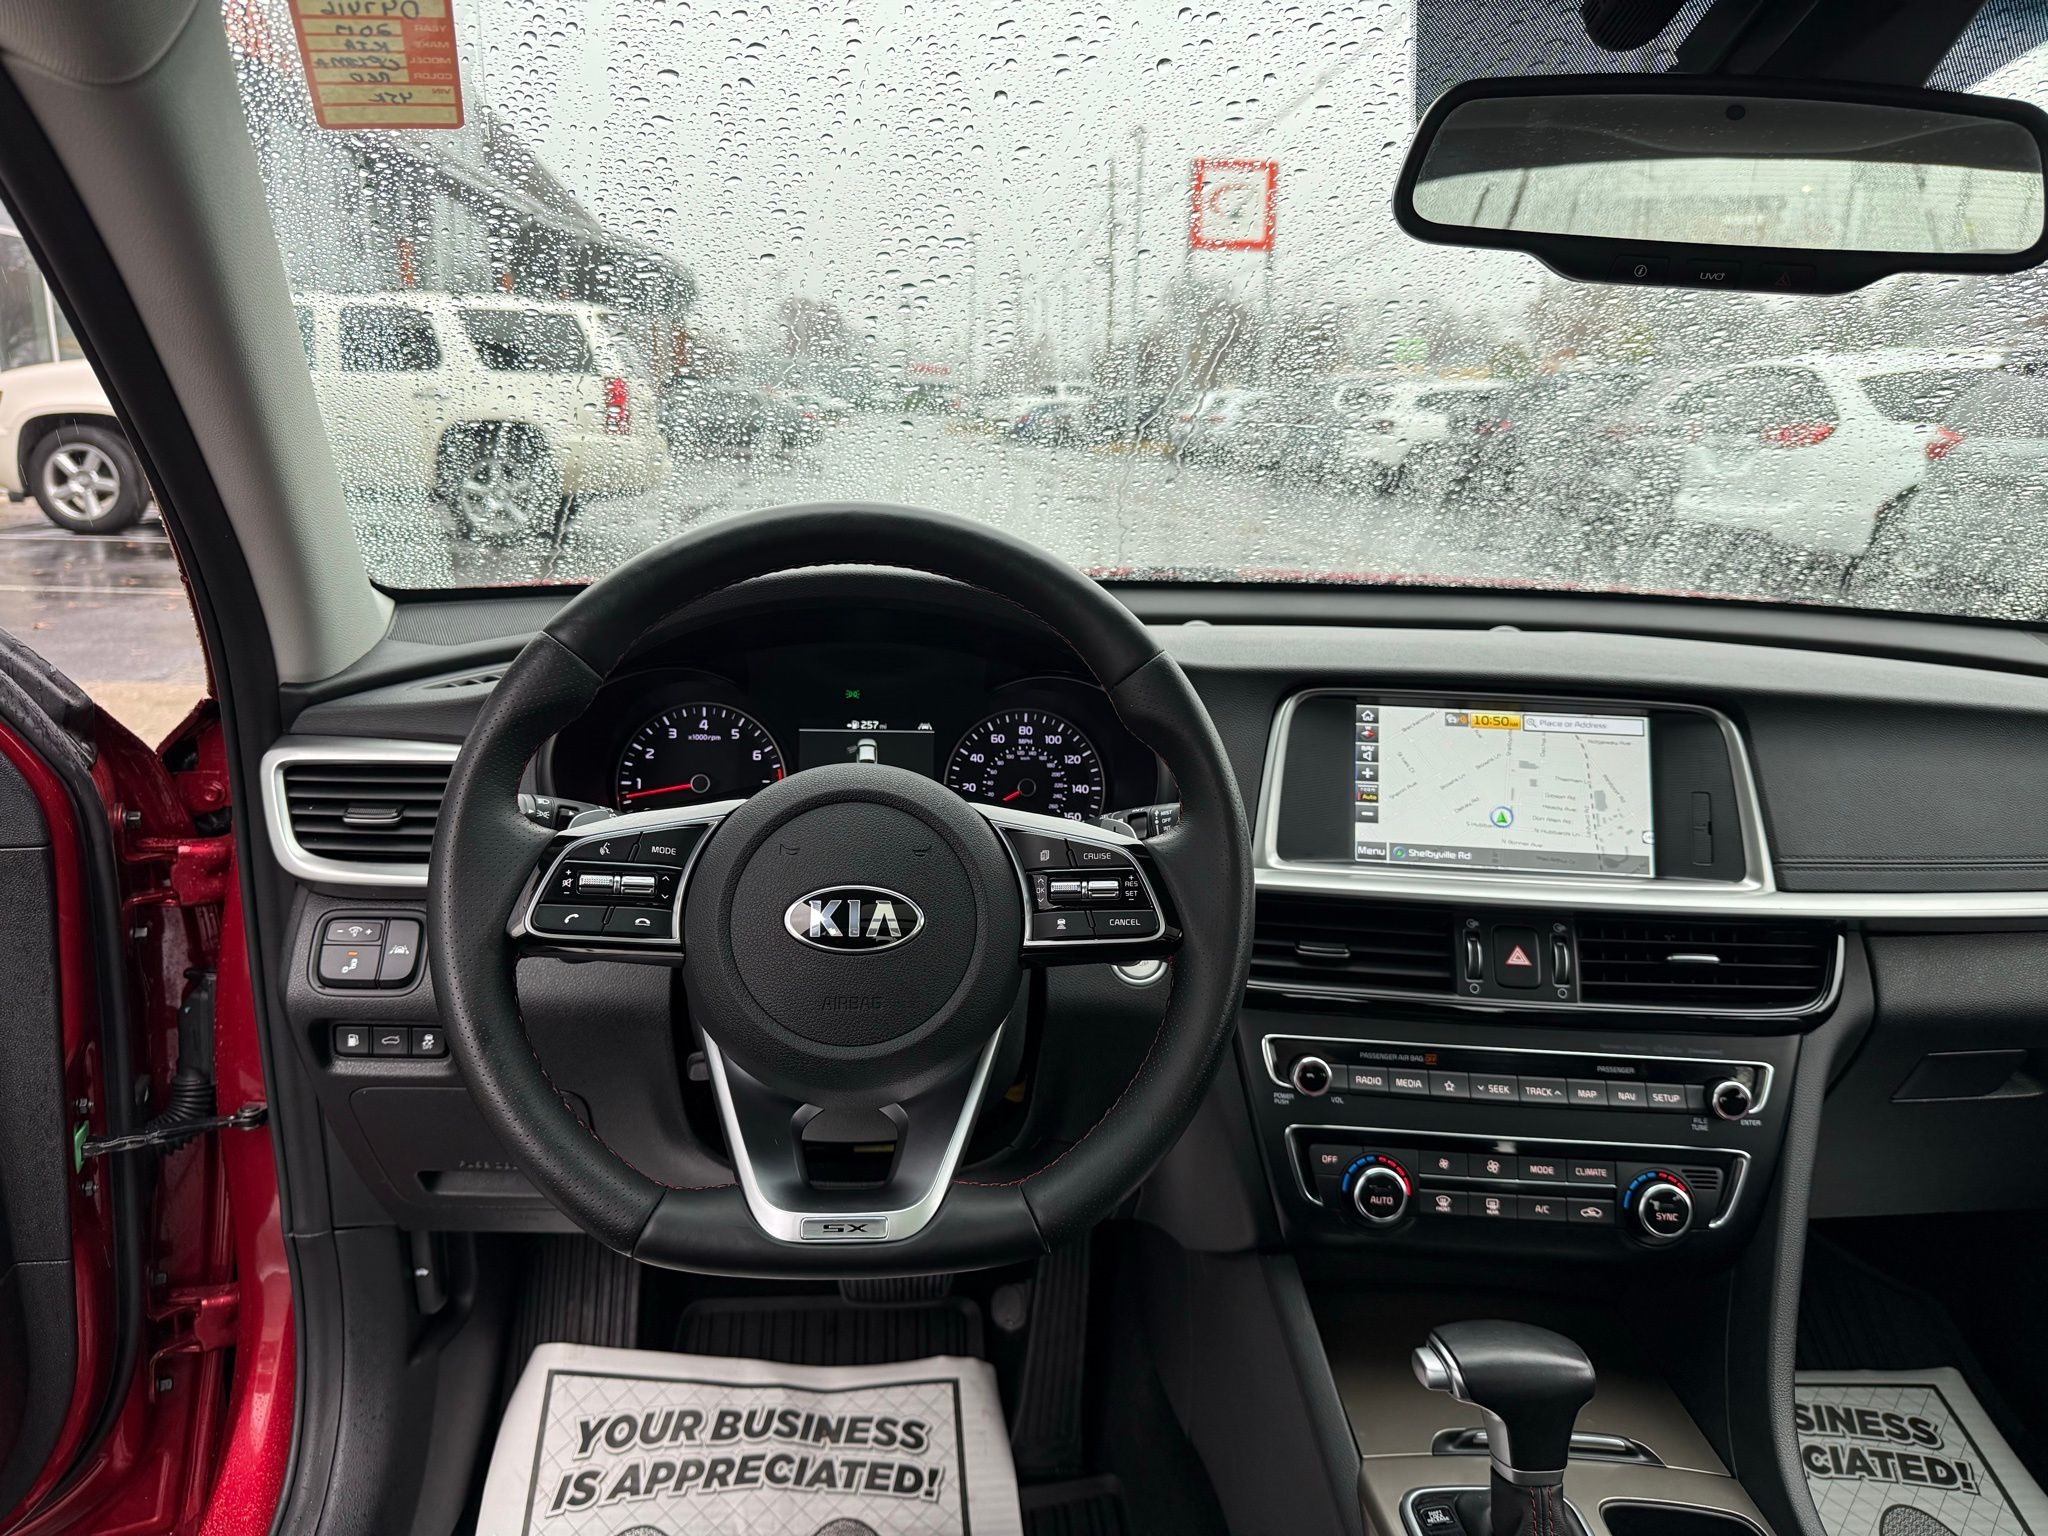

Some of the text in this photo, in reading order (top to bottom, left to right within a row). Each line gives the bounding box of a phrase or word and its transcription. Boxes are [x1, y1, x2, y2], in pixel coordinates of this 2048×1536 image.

[699, 719, 709, 731] 4
[860, 720, 879, 730] 257
[1474, 714, 1510, 727] 10:50
[1539, 719, 1563, 728] Place
[1574, 720, 1608, 729] Address
[668, 728, 677, 739] 3
[731, 728, 740, 740] 5
[1018, 726, 1033, 736] 80
[990, 734, 1005, 744] 60
[1045, 735, 1062, 745] 100
[645, 748, 655, 759] 2
[752, 750, 762, 761] 6
[970, 753, 984, 763] 40
[1064, 755, 1081, 764] 120
[636, 777, 642, 790] 1
[962, 782, 977, 793] 20
[1072, 784, 1089, 794] 140
[1362, 793, 1378, 801] Auto
[651, 846, 677, 855] MODE
[1357, 845, 1386, 856] Menu
[1408, 848, 1472, 860] Shelbyville Rd
[1083, 852, 1112, 860] CRUISE
[1124, 880, 1139, 888] RES
[808, 900, 902, 938] KIA
[1109, 918, 1141, 926] CANCEL
[1359, 1051, 1397, 1061] PASSENGER
[1397, 1053, 1410, 1061] AIR
[1409, 1054, 1424, 1063] BAG
[1597, 1065, 1635, 1074] PASSENGER
[1355, 1075, 1382, 1086] RADIO
[1395, 1078, 1422, 1089] MEDIA
[1488, 1084, 1510, 1095] SEEK
[1525, 1086, 1553, 1097] TRACK
[1577, 1089, 1597, 1099] MAP
[1330, 1096, 1345, 1104] VOL
[1617, 1091, 1636, 1101] NAV
[1652, 1093, 1681, 1103] SETUP
[1740, 1118, 1762, 1126] ENTER
[1321, 1155, 1338, 1164] OFF
[1529, 1165, 1555, 1175] MODE
[1575, 1168, 1607, 1177] CLIMATE
[1370, 1196, 1394, 1206] AUTO
[1535, 1205, 1550, 1214] A/C
[1656, 1212, 1679, 1222] SYNC
[823, 1223, 868, 1234] SX
[576, 1406, 928, 1454] YOUR BUSINESS
[551, 1453, 942, 1511] IS APPRECIATED!
